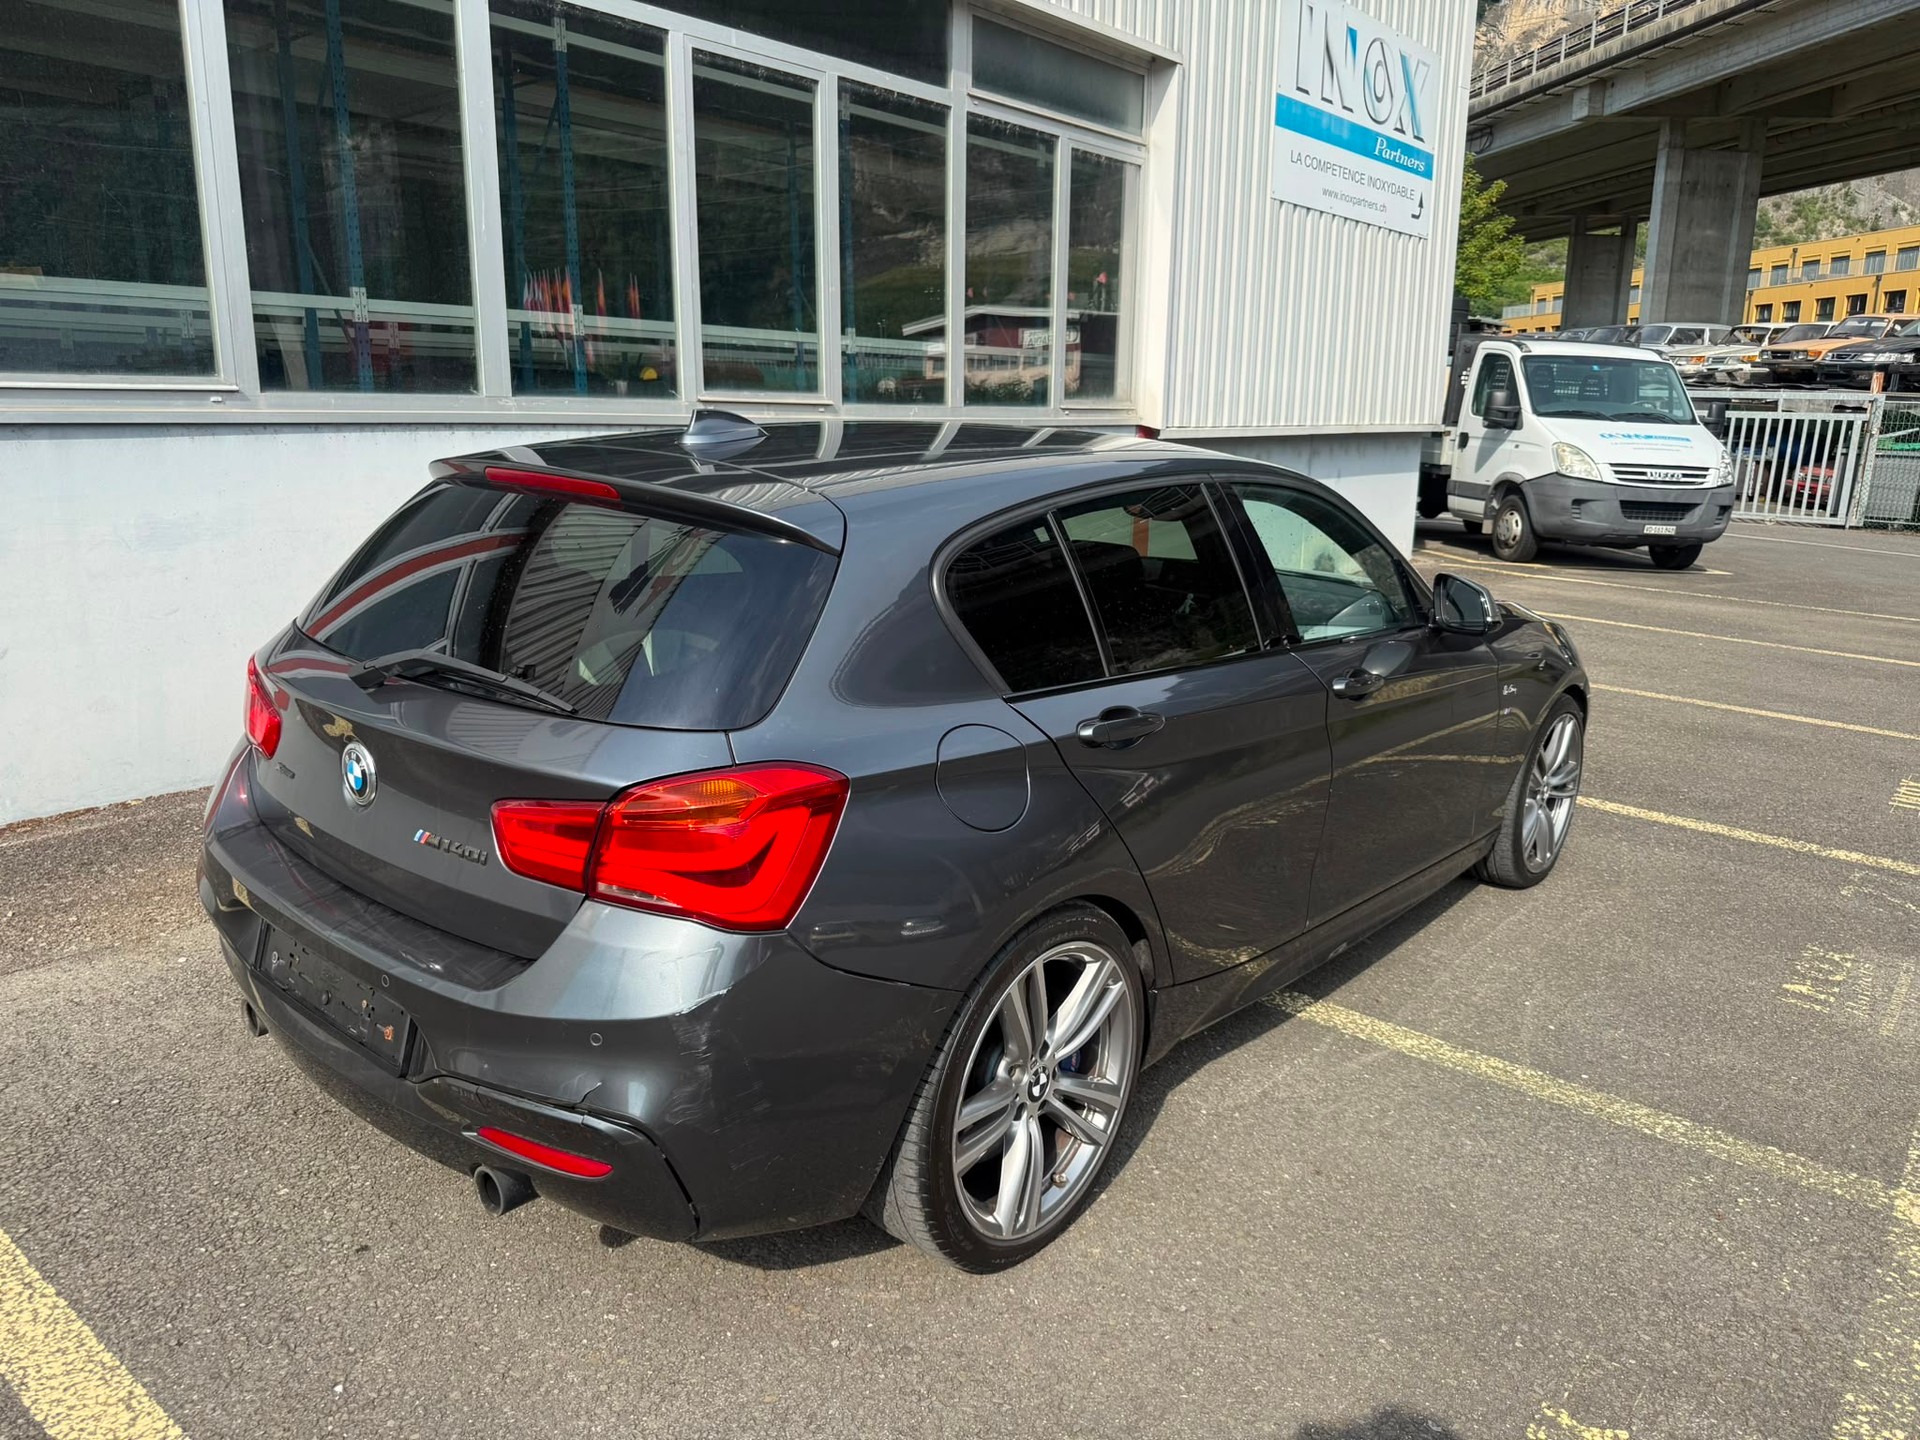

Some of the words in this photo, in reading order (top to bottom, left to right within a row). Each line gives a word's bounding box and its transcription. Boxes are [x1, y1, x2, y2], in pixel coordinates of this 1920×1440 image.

[1296, 0, 1430, 143] INOX
[1374, 136, 1425, 172] Partners
[1290, 150, 1302, 165] LA
[1304, 154, 1366, 186] COMPETENCE
[1367, 175, 1415, 201] INOXYDABLE
[1321, 187, 1387, 214] www.inoxpartners.ch
[1647, 471, 1682, 480] IVECO
